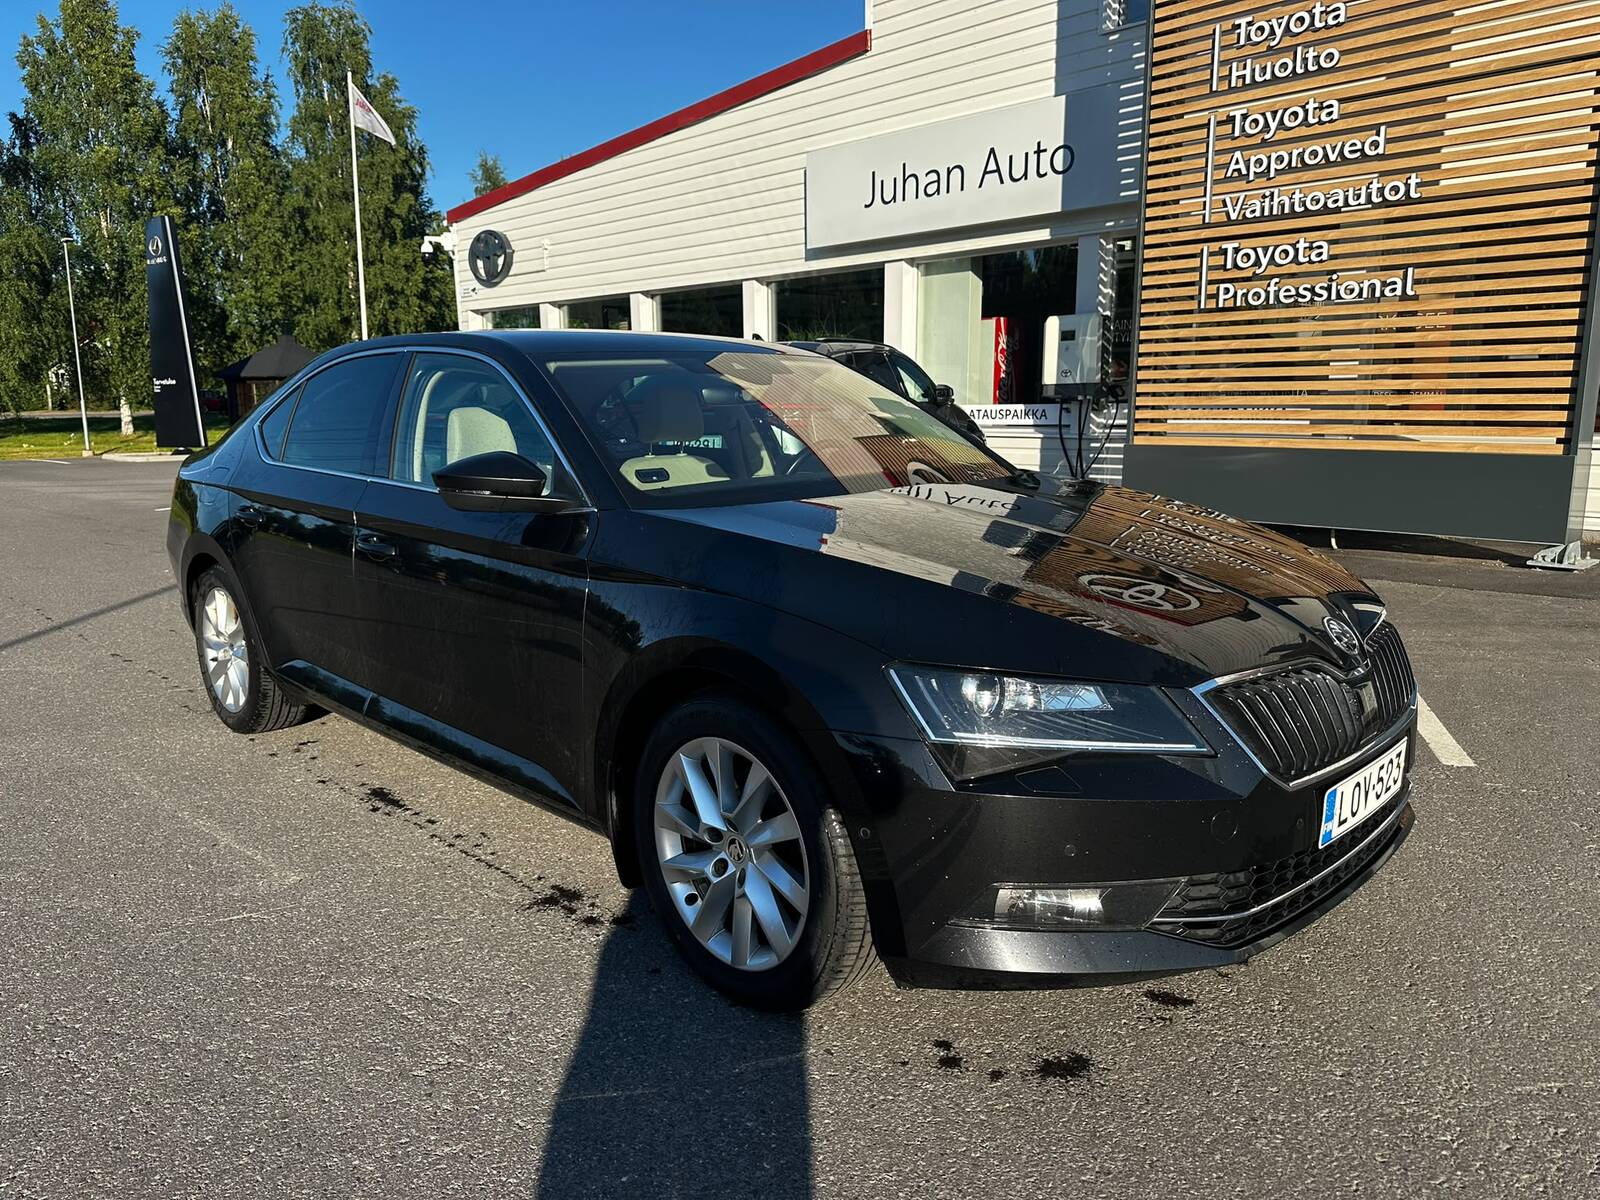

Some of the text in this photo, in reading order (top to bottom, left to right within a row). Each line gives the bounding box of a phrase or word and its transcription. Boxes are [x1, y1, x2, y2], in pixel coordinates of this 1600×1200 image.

[1235, 1, 1346, 47] Toyota
[1231, 46, 1340, 88] Huolto
[1230, 98, 1340, 141] Toyota
[864, 140, 1075, 209] Juhan Auto
[1226, 126, 1386, 181] Approved
[1225, 172, 1422, 221] Vaihtoautot
[1222, 237, 1329, 275] Toyota
[1217, 267, 1416, 308] Professional
[969, 408, 1048, 420] ATAUSPAIKKA
[1337, 750, 1403, 828] LOV-523
